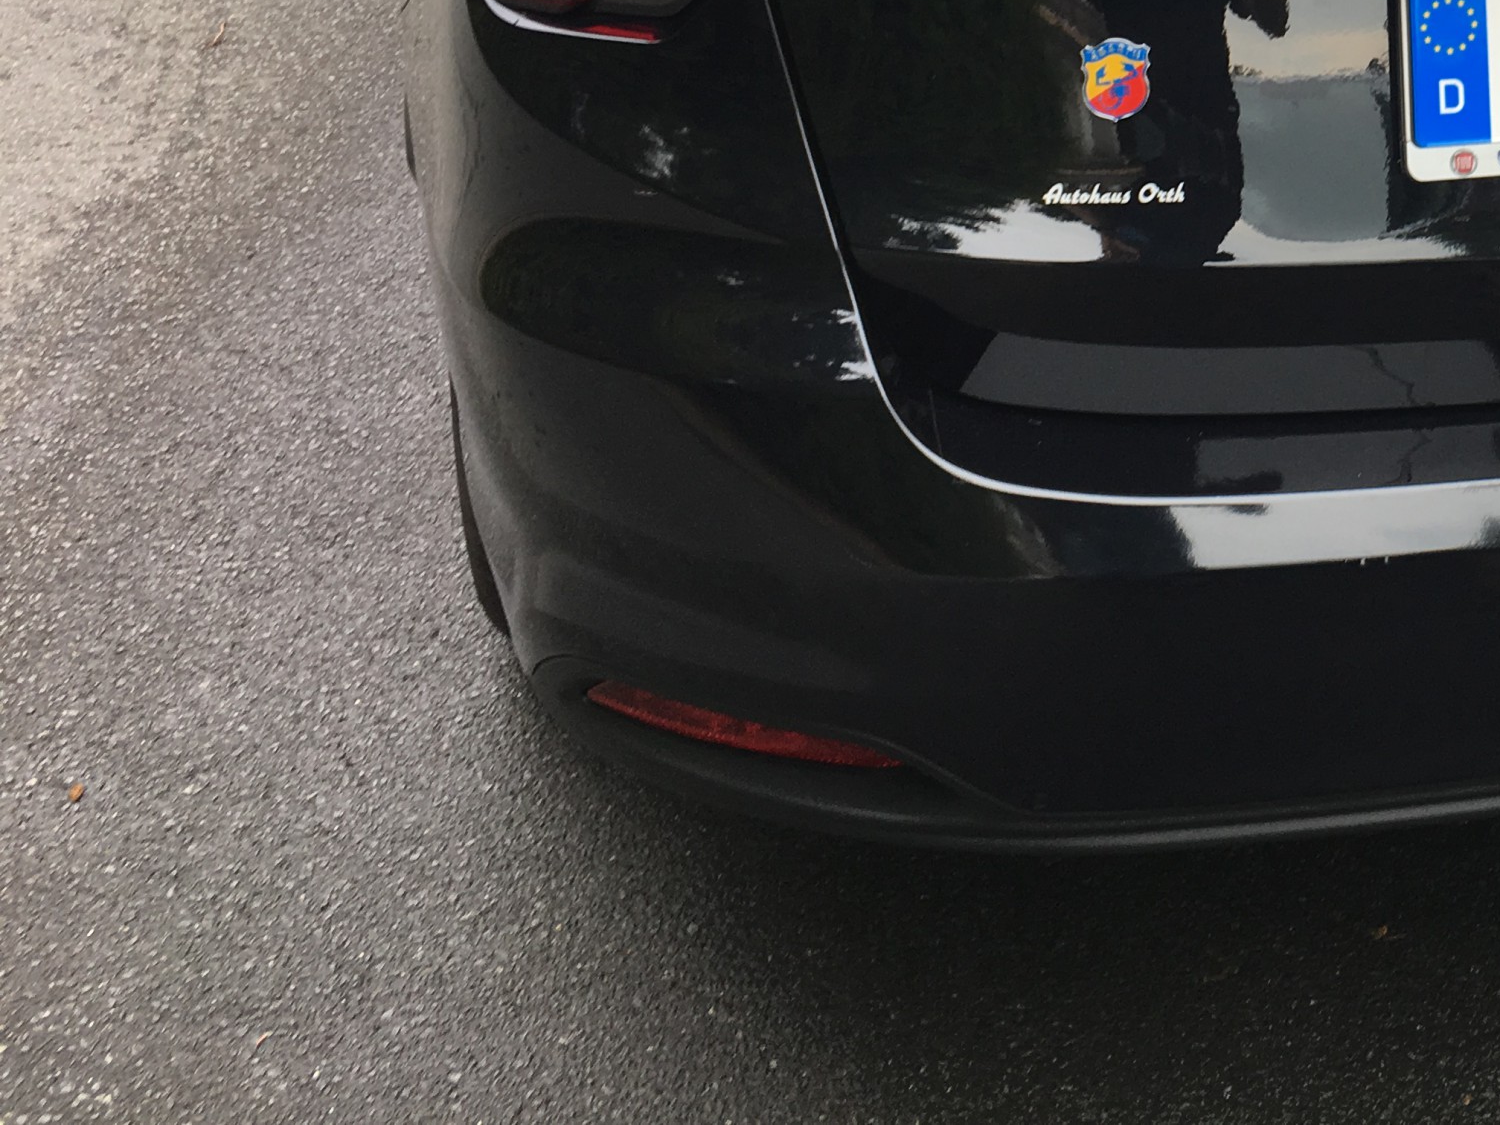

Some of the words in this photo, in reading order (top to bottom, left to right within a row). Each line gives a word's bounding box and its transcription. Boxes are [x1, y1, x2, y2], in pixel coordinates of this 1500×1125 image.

[1438, 79, 1466, 116] D
[1042, 183, 1131, 205] Autohaus
[1138, 182, 1185, 204] Orth
